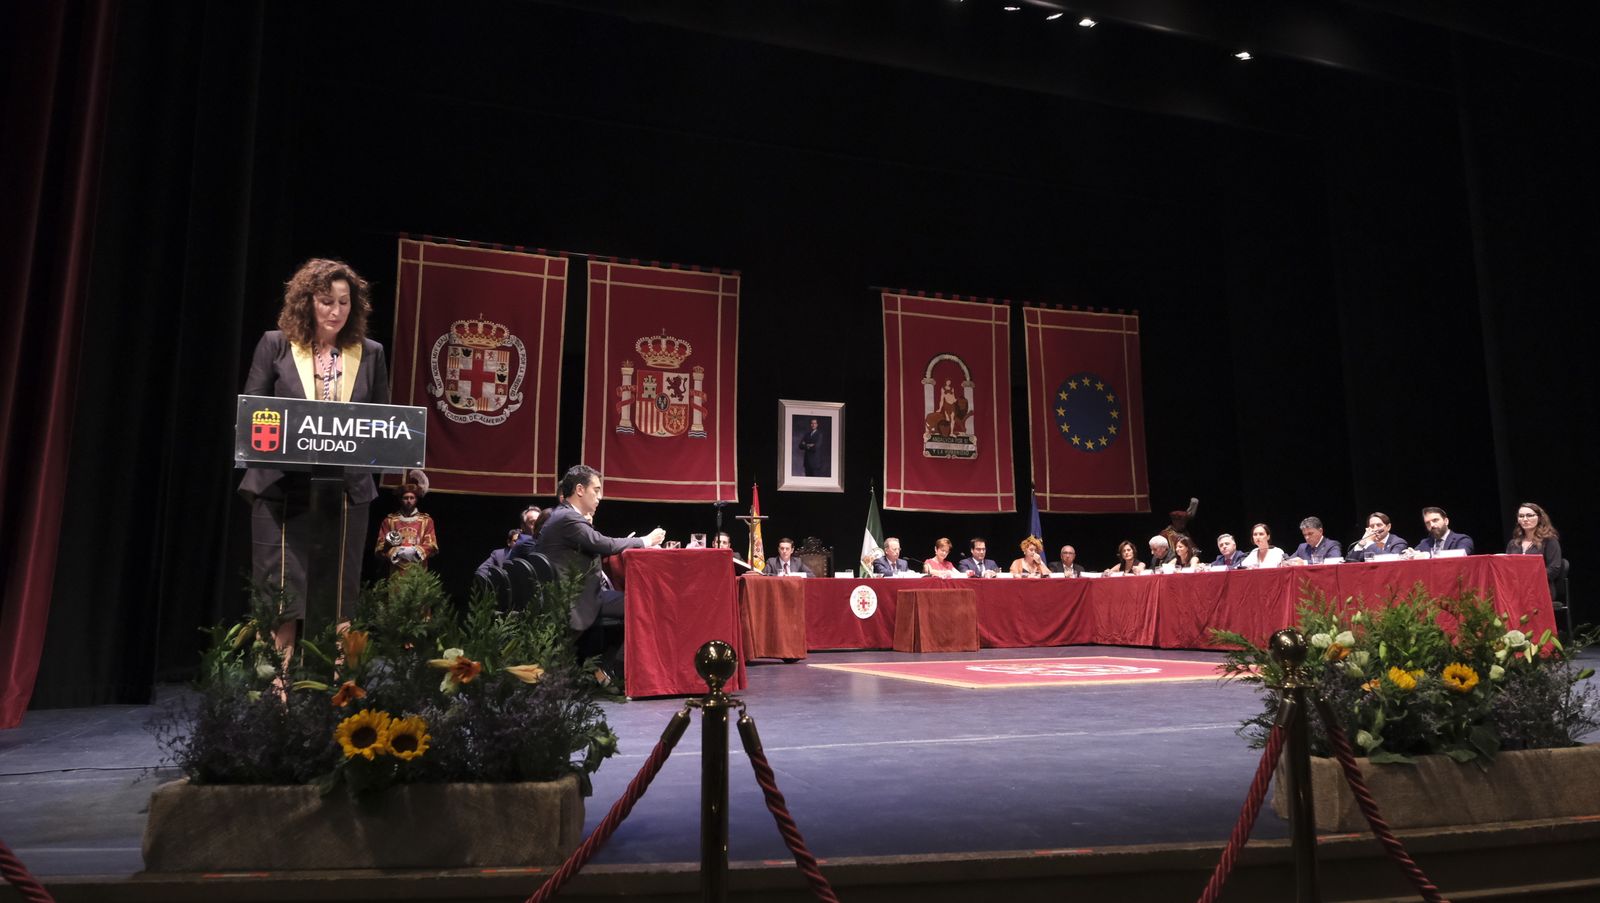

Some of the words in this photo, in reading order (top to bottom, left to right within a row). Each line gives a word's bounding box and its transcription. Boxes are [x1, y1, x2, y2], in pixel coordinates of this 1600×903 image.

[447, 412, 467, 422] CIUDAD
[298, 415, 412, 440] ALMERÍA
[297, 437, 357, 453] CIUDAD
